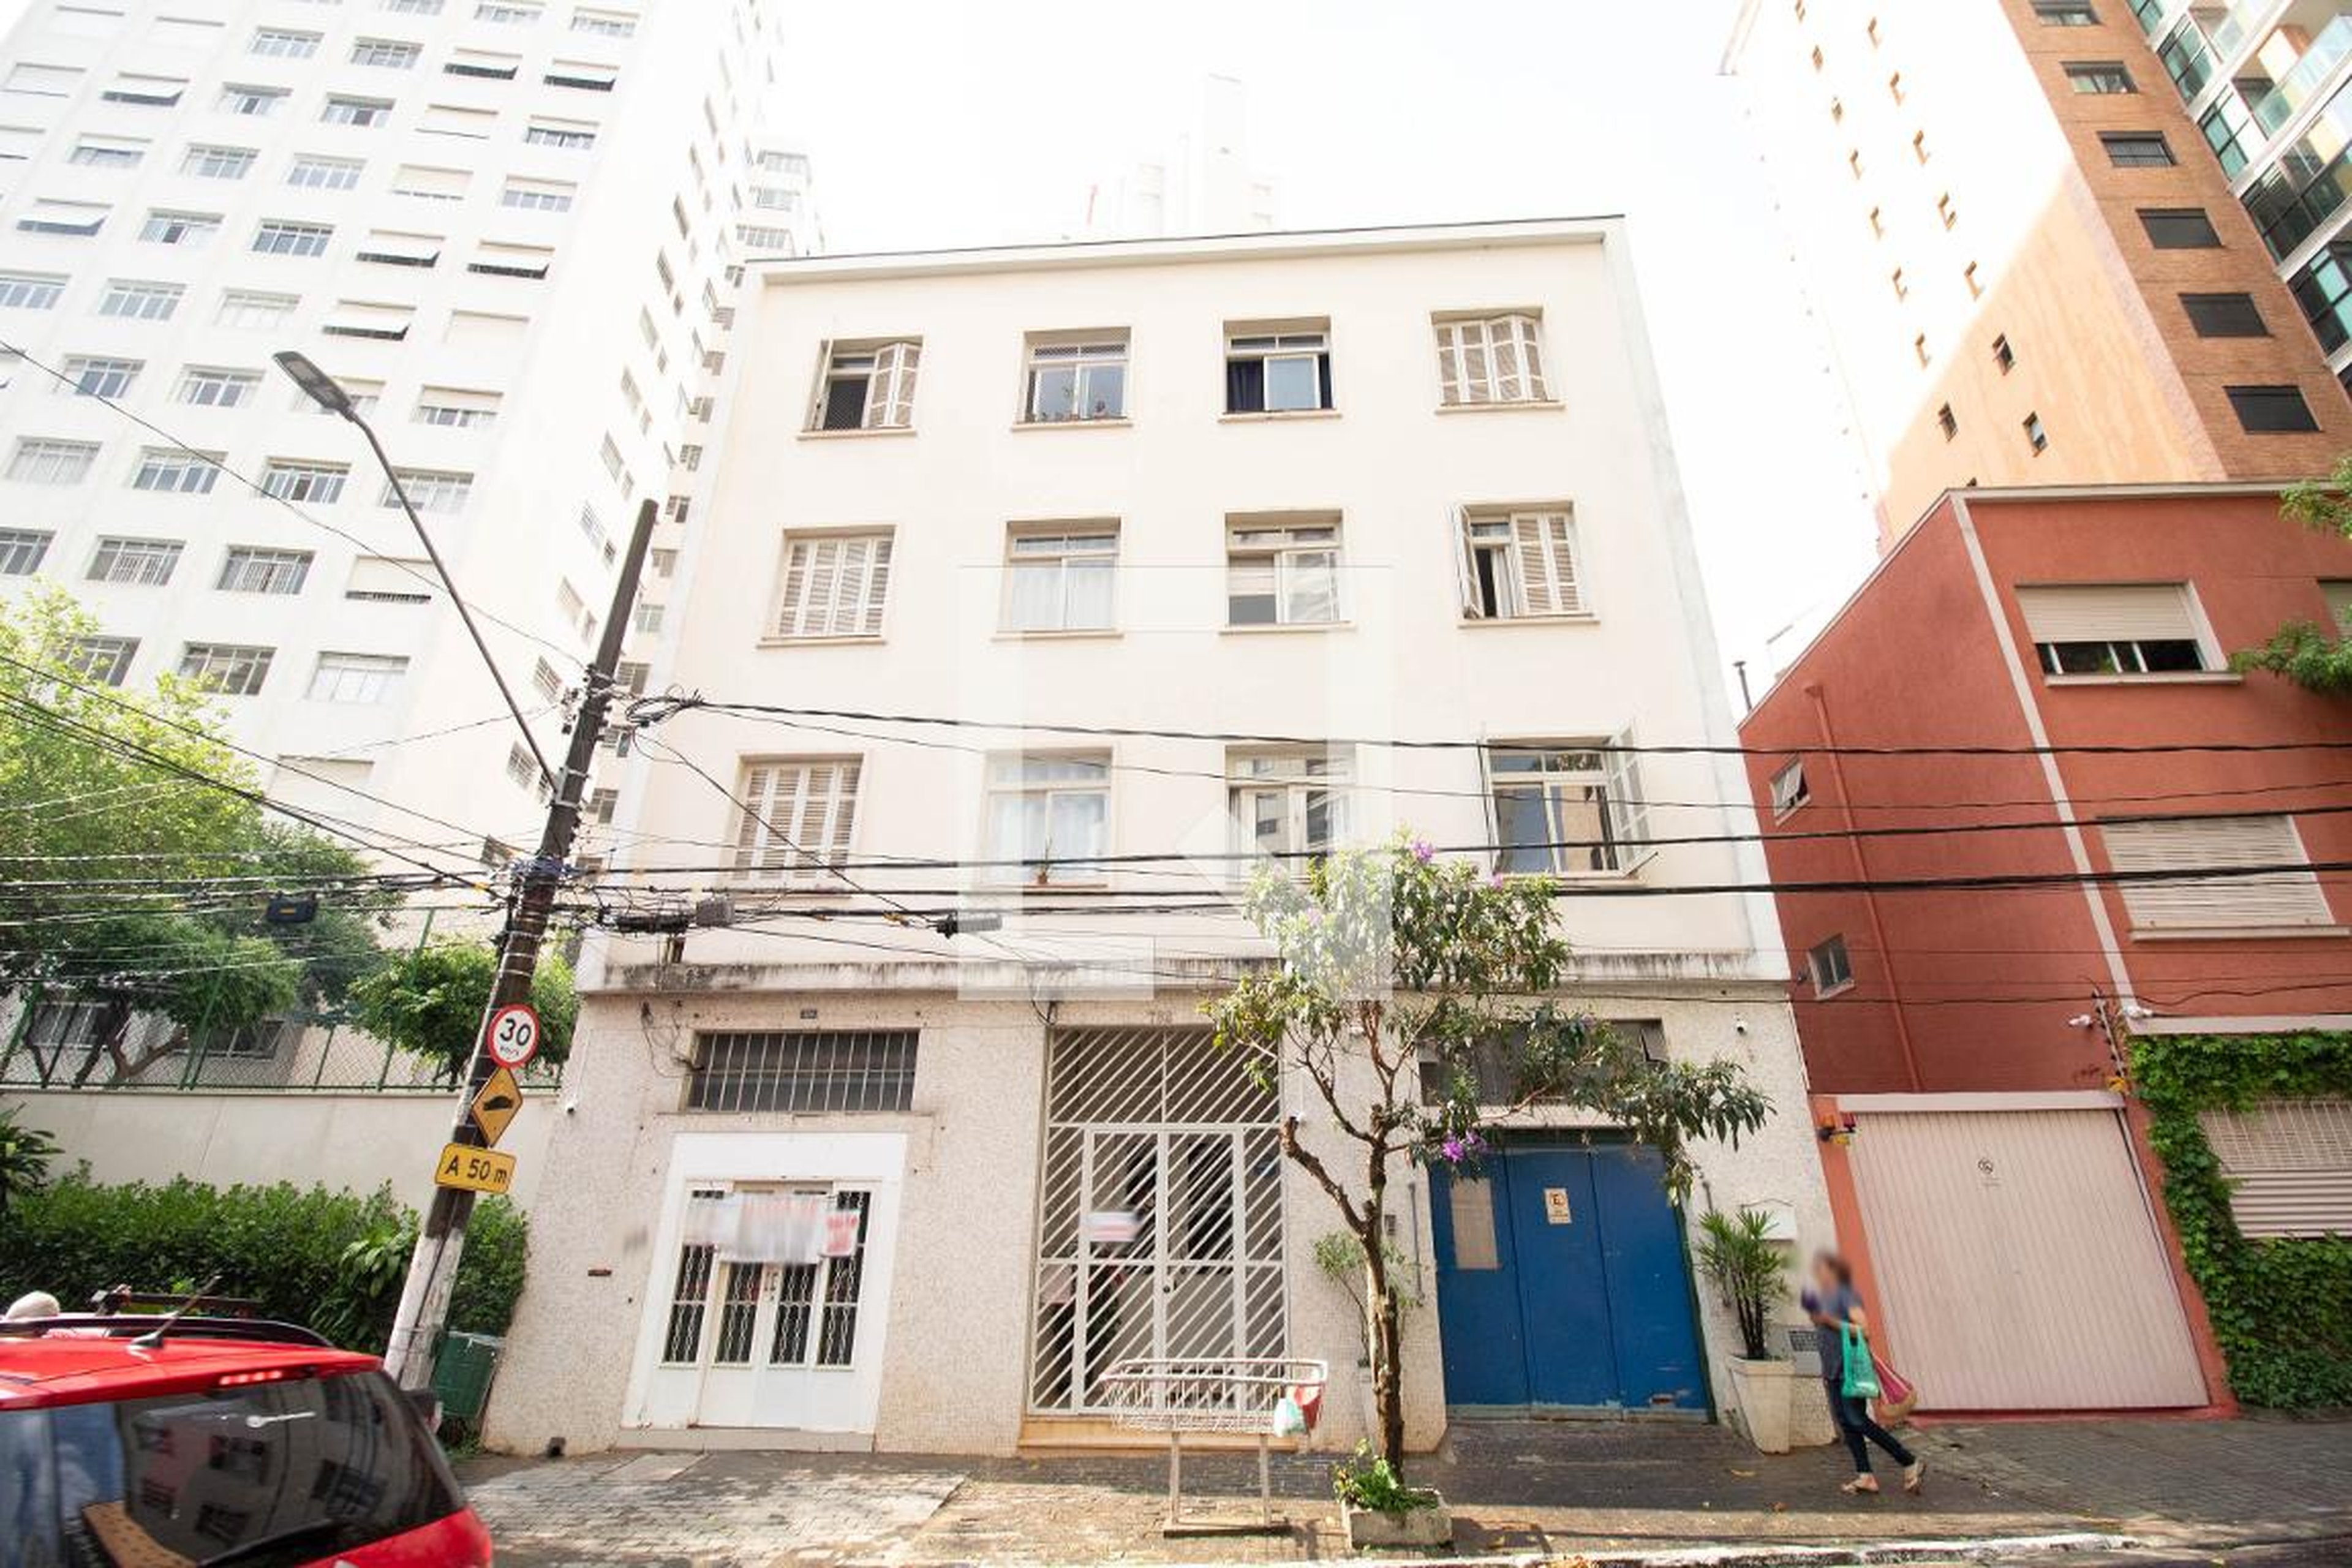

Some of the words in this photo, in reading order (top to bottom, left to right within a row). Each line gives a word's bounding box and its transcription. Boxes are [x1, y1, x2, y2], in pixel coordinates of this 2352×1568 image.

[500, 1018, 531, 1046] 30
[444, 1155, 459, 1177] A
[467, 1158, 491, 1181] 50
[494, 1168, 508, 1183] m
